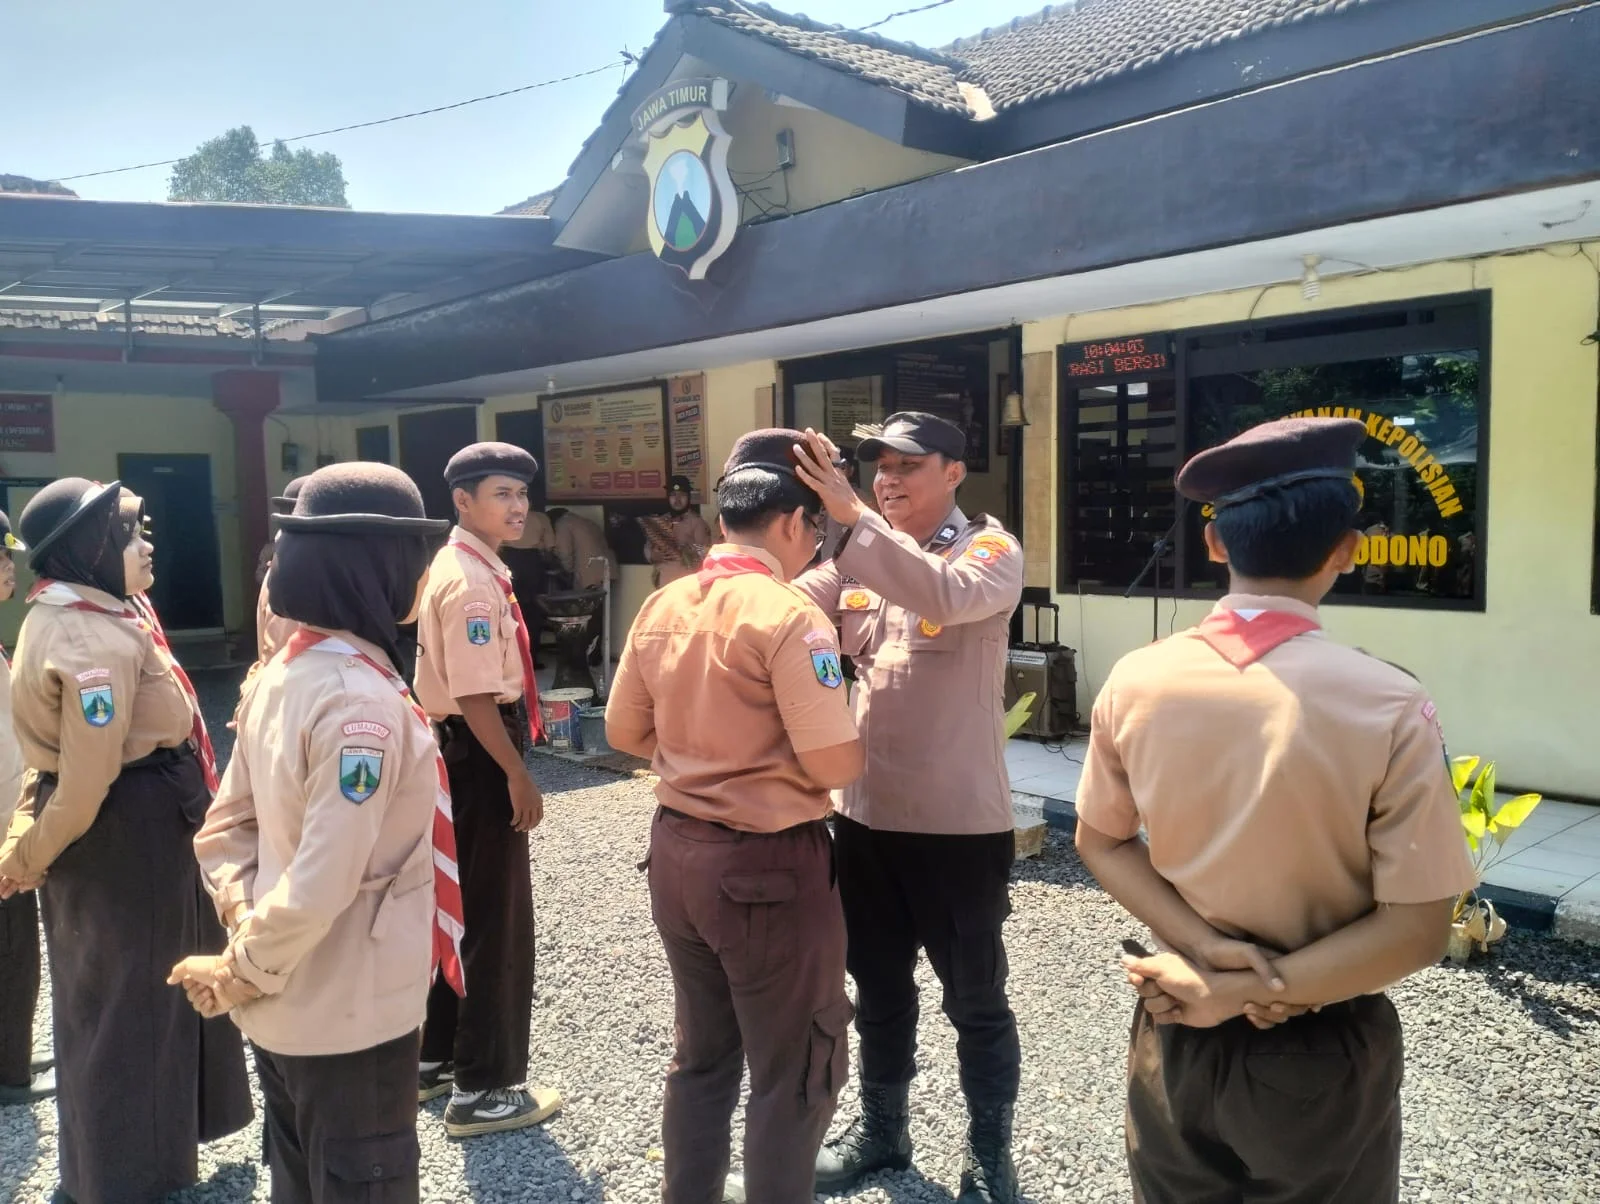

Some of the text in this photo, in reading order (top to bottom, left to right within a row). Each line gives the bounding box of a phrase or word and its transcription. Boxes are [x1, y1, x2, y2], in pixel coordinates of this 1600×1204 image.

[637, 85, 707, 131] JAWA TIMUR
[1366, 414, 1464, 519] KEPOLISIAN
[346, 722, 387, 737] LUMAJANG
